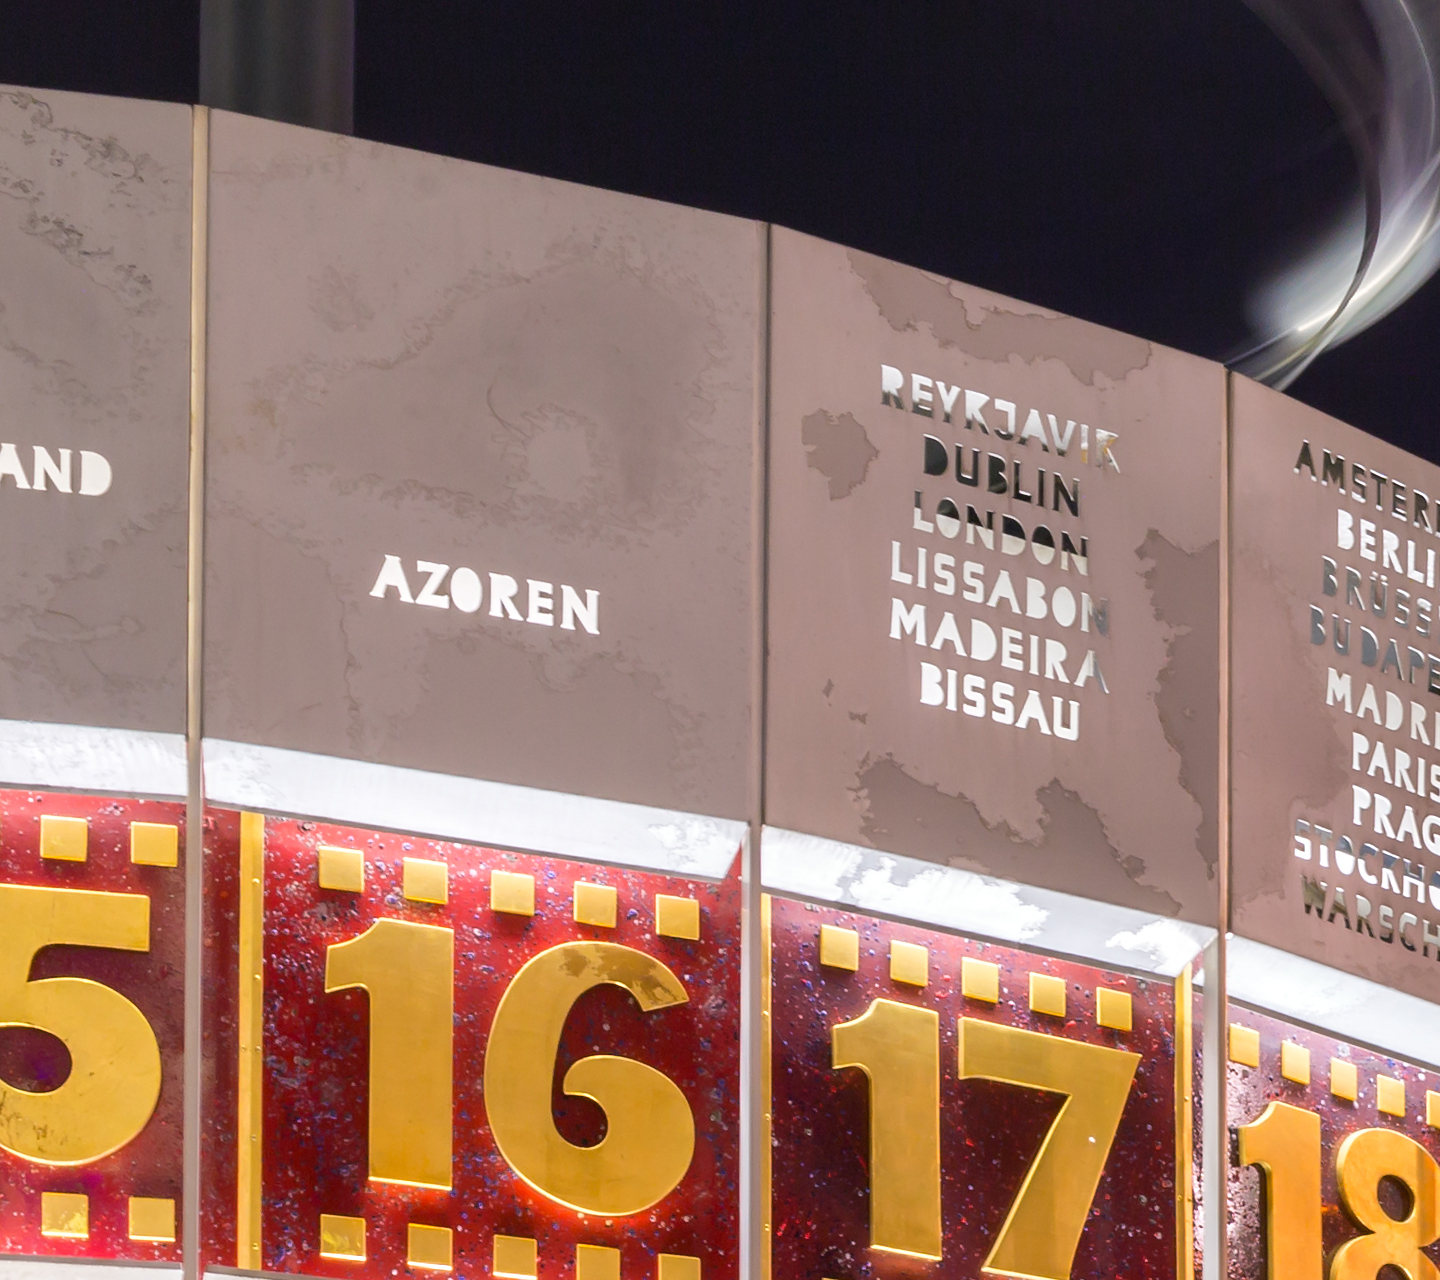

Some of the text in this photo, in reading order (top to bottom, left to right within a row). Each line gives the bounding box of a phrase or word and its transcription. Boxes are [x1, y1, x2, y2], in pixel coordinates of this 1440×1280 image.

[880, 363, 1121, 474] REYKJAVIK
[922, 433, 1081, 518] DUBLIN
[912, 490, 1090, 577] LONDON
[369, 554, 601, 635] AZOREN
[890, 541, 1110, 638] LISSABON
[889, 597, 1110, 694] MADEIRA
[919, 661, 1080, 741] BISSAU
[324, 917, 697, 1218] 16
